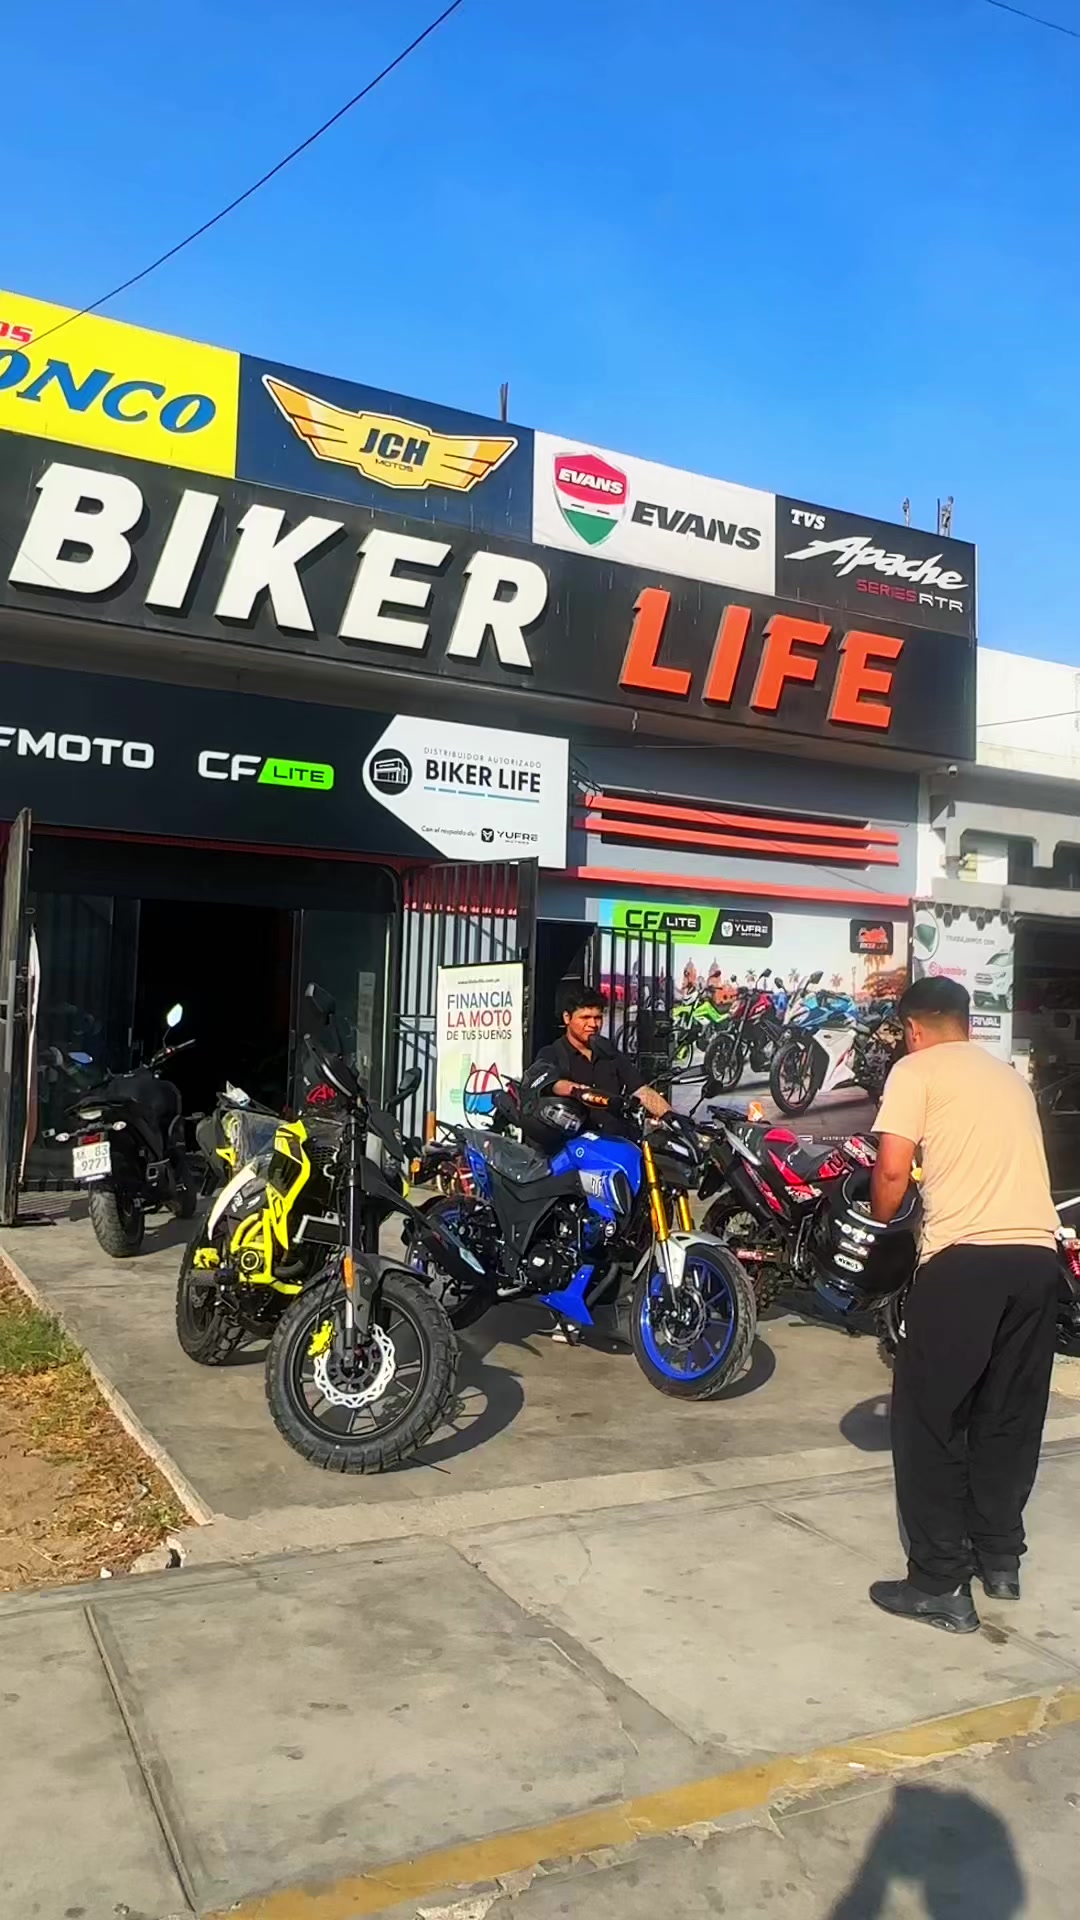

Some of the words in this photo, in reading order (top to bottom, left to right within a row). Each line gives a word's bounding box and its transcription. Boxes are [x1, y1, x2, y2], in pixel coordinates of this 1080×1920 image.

[359, 428, 431, 467] JCH
[375, 458, 413, 472] MOTOS
[558, 468, 624, 495] EVANS
[631, 500, 762, 551] EVANS
[790, 508, 826, 531] TVS
[784, 536, 969, 590] Apache
[8, 461, 549, 669] BIKER
[619, 586, 904, 731] LIFE
[856, 579, 918, 604] SERIES
[918, 592, 963, 613] RTR
[198, 750, 262, 782] CF
[273, 765, 325, 784] LITE
[424, 747, 484, 761] DISTRIBUIDOR
[488, 756, 541, 769] AUTORIZADO
[426, 759, 492, 787] BIKER
[498, 768, 540, 793] LIFE
[497, 830, 538, 841] YUFRE
[625, 909, 660, 929] CF
[666, 916, 697, 928] LITE
[734, 924, 768, 934] YUFRE
[447, 990, 513, 1010] FINANCIA
[447, 1011, 466, 1027] LA
[469, 1009, 512, 1027] MOTO
[446, 1030, 459, 1040] DE
[461, 1030, 476, 1040] TUS
